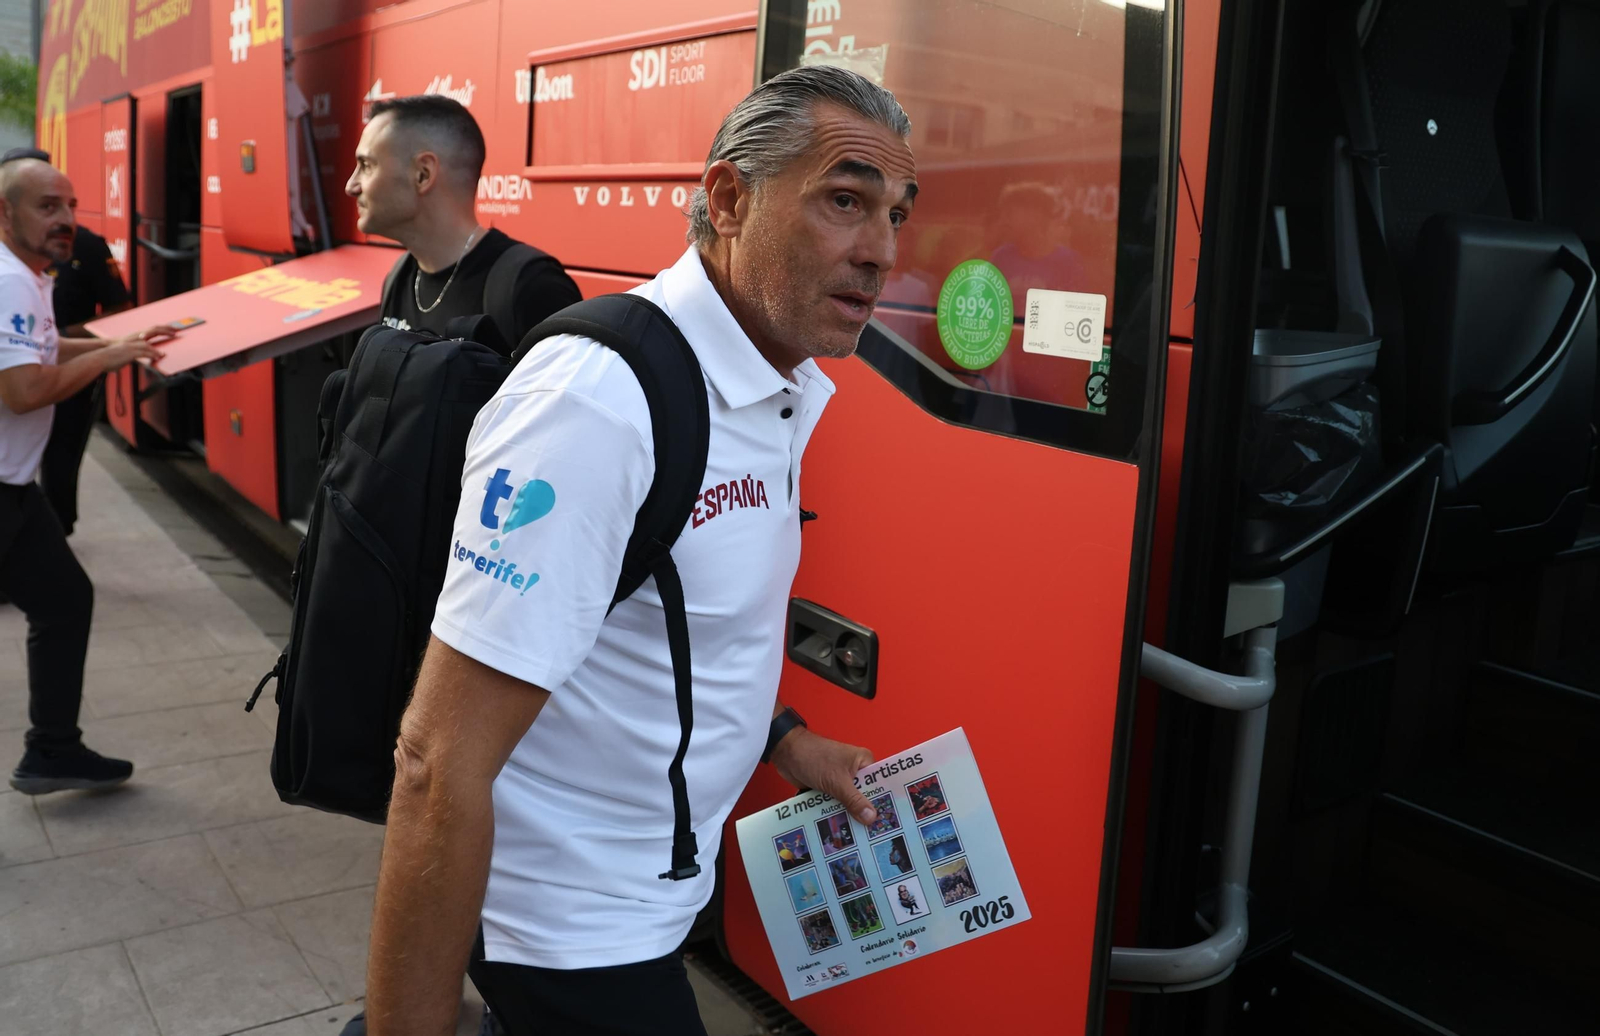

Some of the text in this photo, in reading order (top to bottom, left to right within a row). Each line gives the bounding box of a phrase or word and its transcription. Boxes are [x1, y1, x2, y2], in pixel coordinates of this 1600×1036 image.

[628, 46, 667, 91] SDI
[670, 41, 706, 64] SPORT
[515, 66, 574, 104] Wlson
[669, 64, 706, 86] FLOOR
[478, 174, 533, 200] INDIBA
[573, 186, 688, 207] VOLVO
[955, 295, 994, 319] 99%
[968, 264, 1006, 297] EQUIPADO
[1001, 299, 1010, 325] CON
[958, 317, 989, 330] LIBRE DE
[941, 324, 1006, 365] FILTRO BIOACTIVO
[692, 474, 769, 530] ESPAÑA
[454, 540, 540, 597] tenerife!
[775, 805, 791, 821] 12
[794, 790, 835, 815] mese
[864, 753, 923, 786] artistas
[862, 785, 885, 797] Simón
[959, 896, 1015, 934] 2025
[860, 937, 895, 953] Calendario
[896, 925, 927, 940] Solidario
